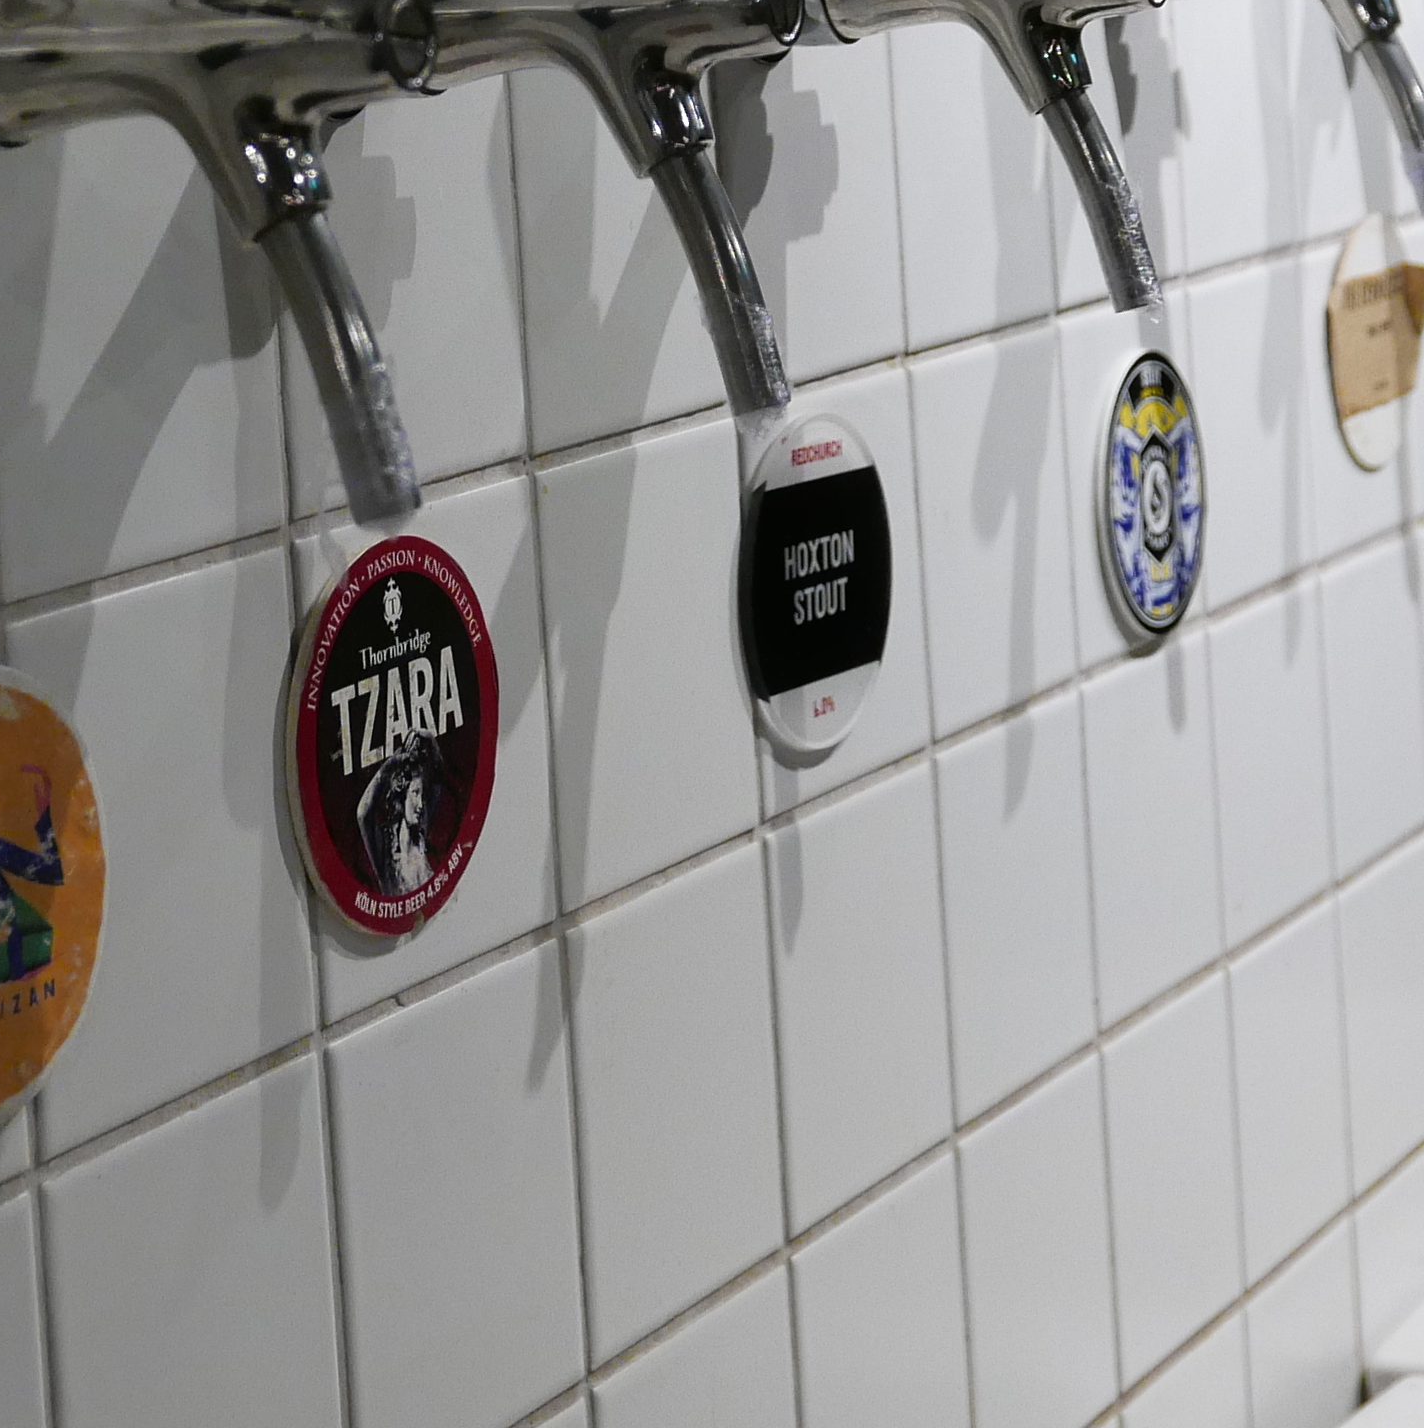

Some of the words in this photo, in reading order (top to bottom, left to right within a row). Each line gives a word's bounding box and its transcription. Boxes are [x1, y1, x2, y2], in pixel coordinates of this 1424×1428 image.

[784, 529, 855, 581] HOXTON
[307, 576, 362, 712] INNOVATION
[366, 549, 416, 581] PASSION
[423, 553, 483, 648] KNOWLEDGE
[793, 577, 849, 626] STOUT
[358, 628, 432, 670] Thornbridge
[330, 645, 466, 777] TZARA
[378, 900, 404, 919] STYLE
[405, 891, 427, 915] BEER
[448, 843, 464, 875] ABV
